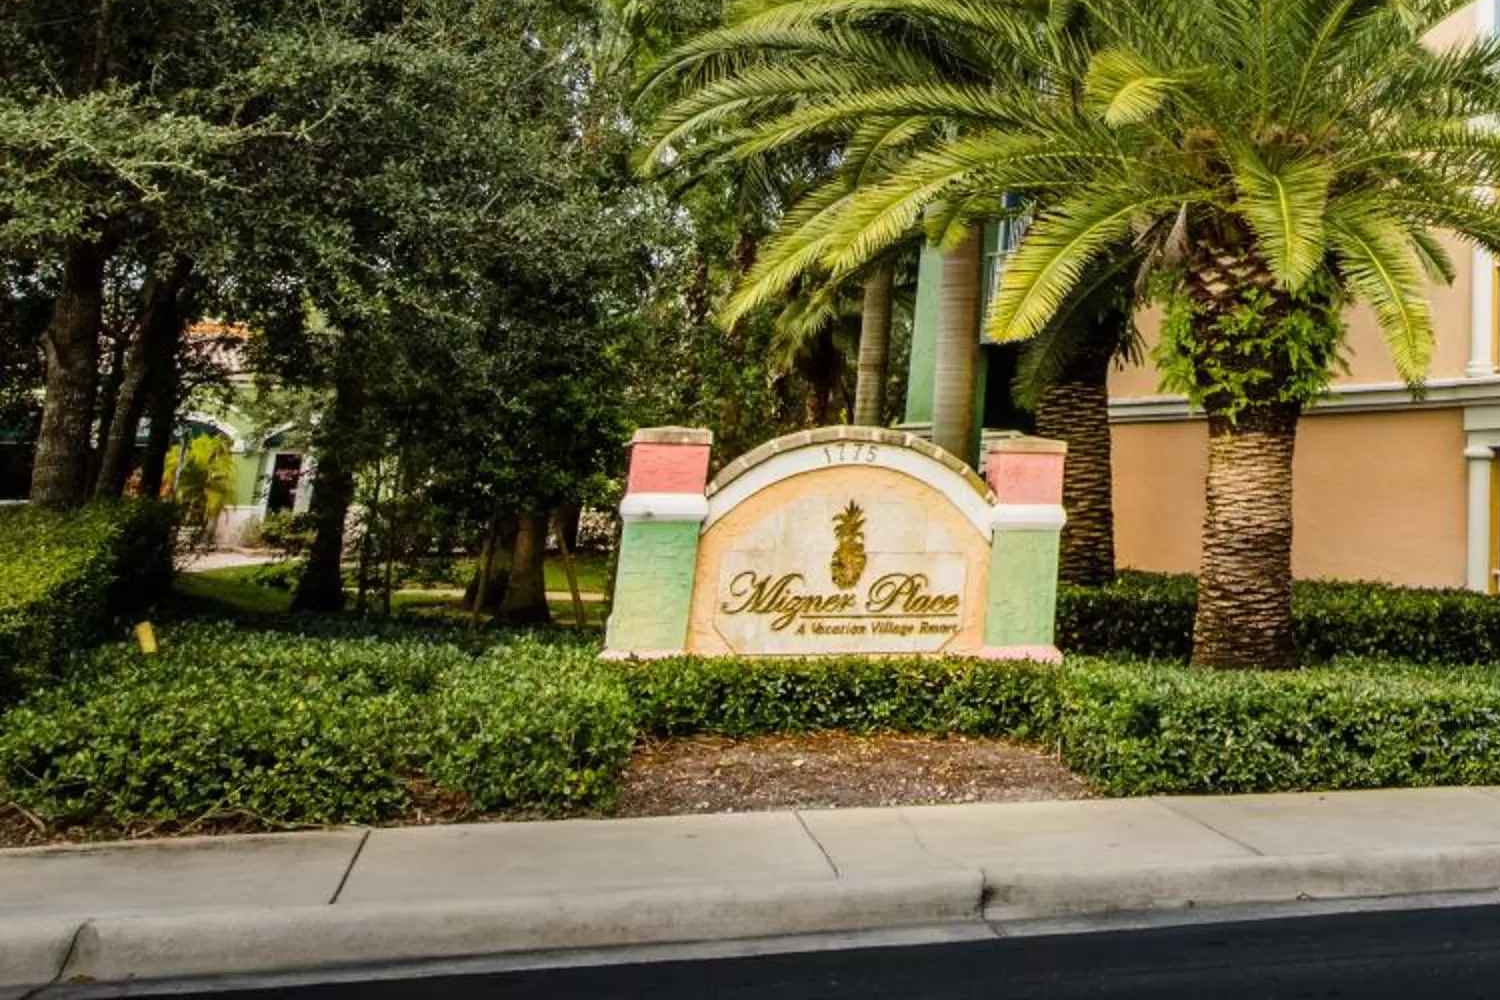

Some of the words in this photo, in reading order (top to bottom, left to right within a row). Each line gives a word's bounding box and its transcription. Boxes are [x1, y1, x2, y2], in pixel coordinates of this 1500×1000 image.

[824, 443, 878, 464] 1775
[722, 571, 857, 631] Mizner
[865, 572, 960, 613] Place
[795, 622, 806, 635] A
[811, 620, 867, 636] Vacation
[871, 621, 915, 637] Village
